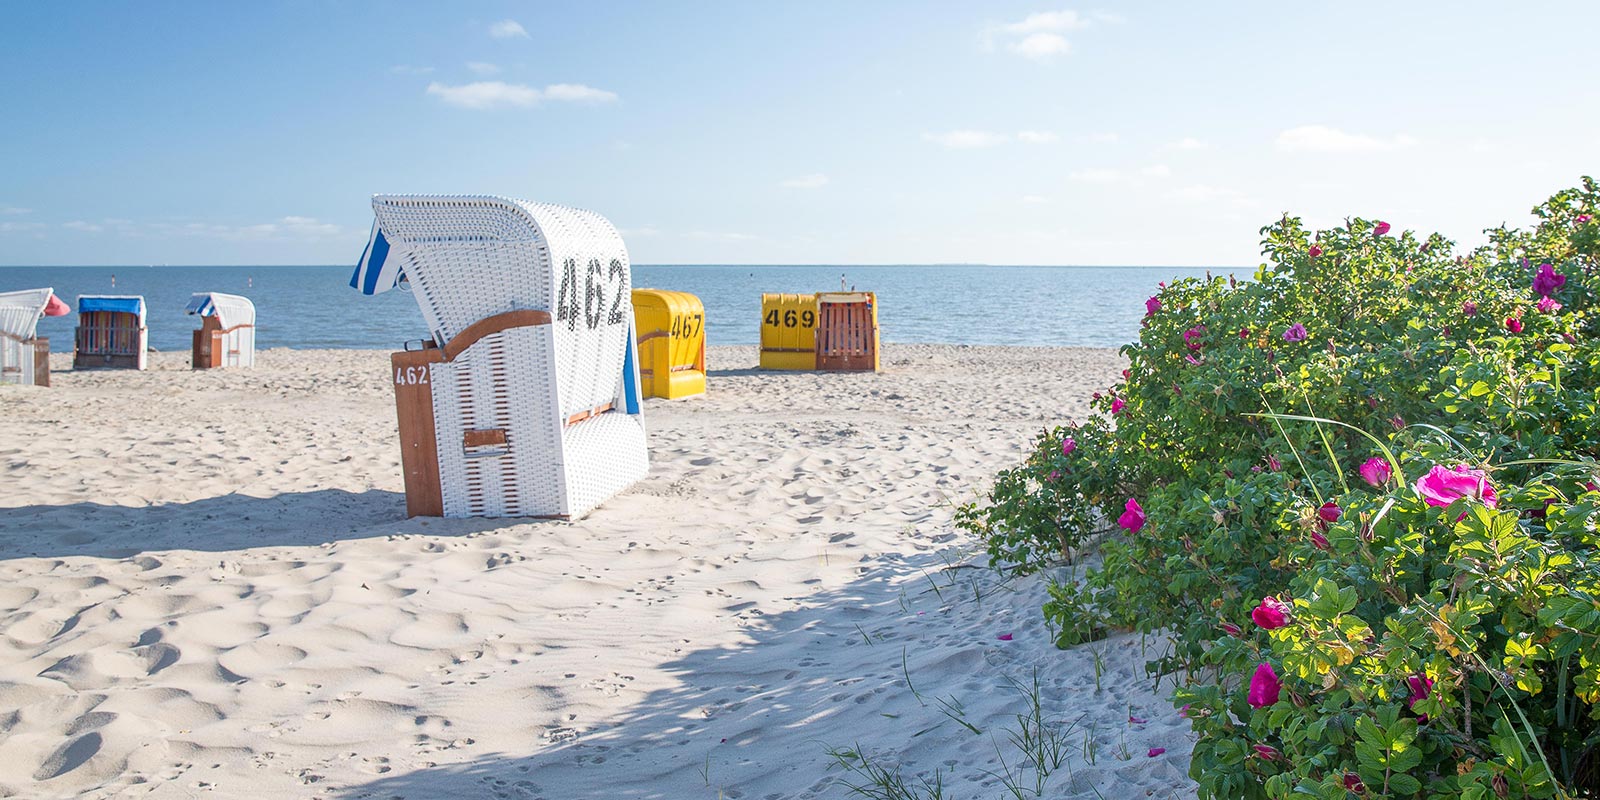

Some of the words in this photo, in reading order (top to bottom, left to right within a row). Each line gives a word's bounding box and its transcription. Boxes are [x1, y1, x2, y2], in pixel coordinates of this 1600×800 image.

[557, 258, 625, 331] 462
[671, 314, 701, 340] 467
[765, 309, 814, 328] 469
[396, 367, 428, 385] 462
